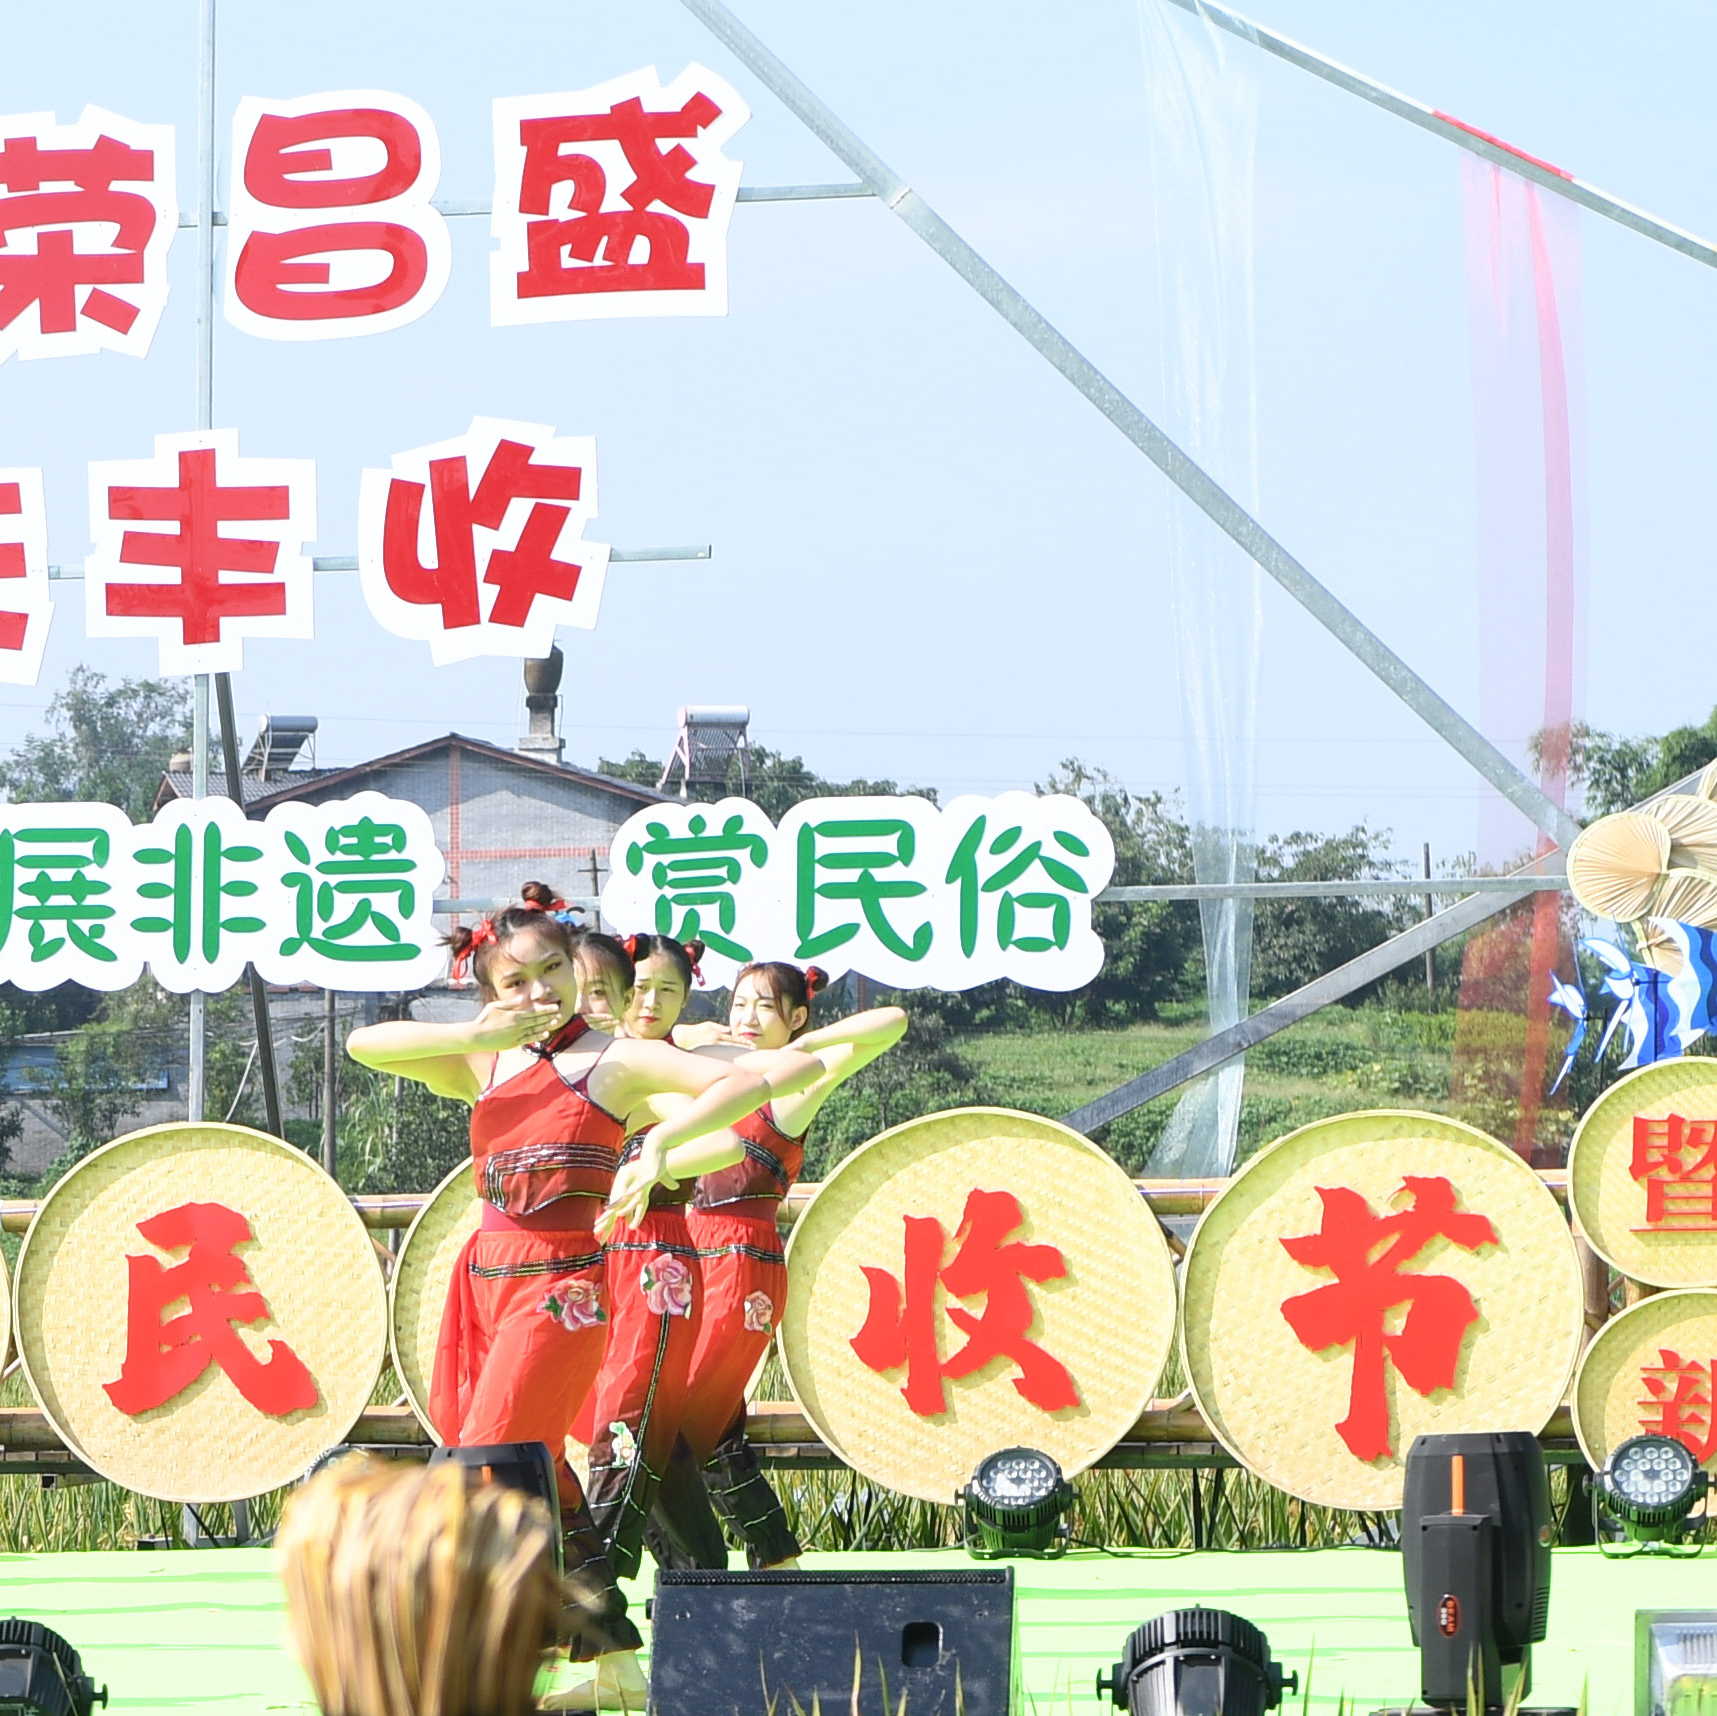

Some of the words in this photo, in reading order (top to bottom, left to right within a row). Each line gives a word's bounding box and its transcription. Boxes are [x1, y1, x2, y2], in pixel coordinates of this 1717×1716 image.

[626, 813, 1089, 963] 赏民俗
[102, 1202, 319, 1416] 民
[849, 1188, 1081, 1417] 收
[1278, 1175, 1500, 1462] 节
[1447, 1600, 1455, 1632] BEAM
